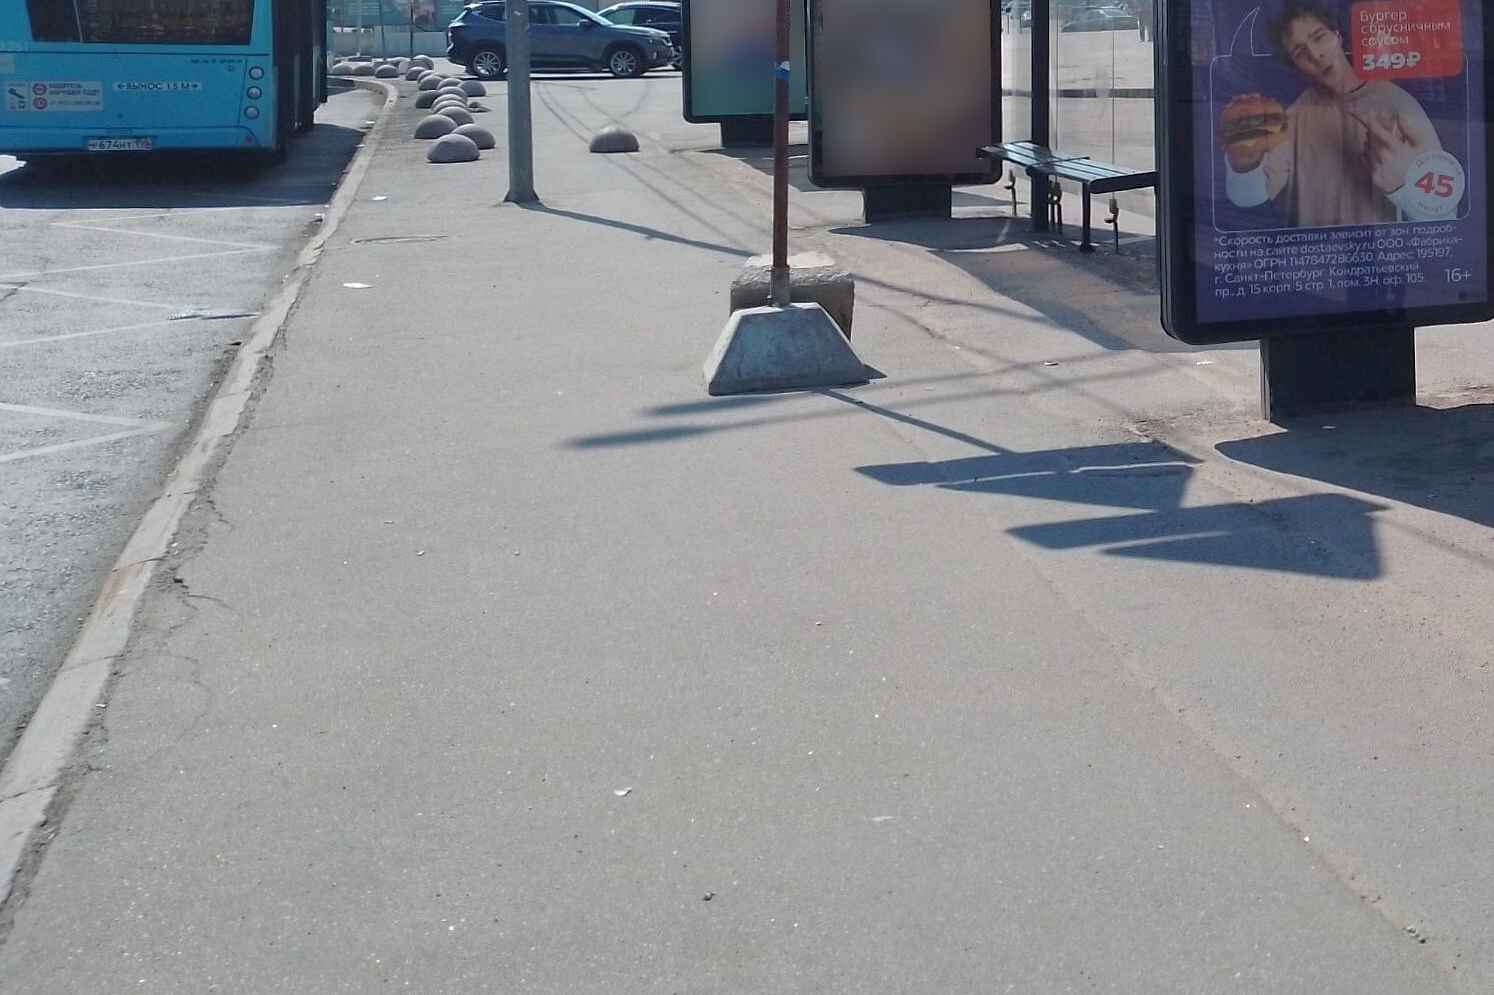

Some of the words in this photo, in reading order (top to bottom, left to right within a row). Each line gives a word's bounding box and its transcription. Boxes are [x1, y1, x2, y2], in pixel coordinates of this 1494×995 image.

[1360, 10, 1408, 23] Бургер
[1369, 22, 1452, 37] брусничным
[1361, 35, 1409, 48] соусом
[1414, 171, 1456, 198] 45
[1275, 233, 1327, 245] доставки
[1329, 230, 1372, 241] зависит
[1374, 228, 1387, 237] от
[1214, 249, 1248, 260] ности
[1249, 248, 1264, 257] на
[1265, 245, 1298, 256] сайте
[1376, 237, 1404, 250] ООО
[1253, 256, 1287, 270] ОГРН
[1444, 267, 1472, 283] 16+
[1248, 283, 1261, 295] 15
